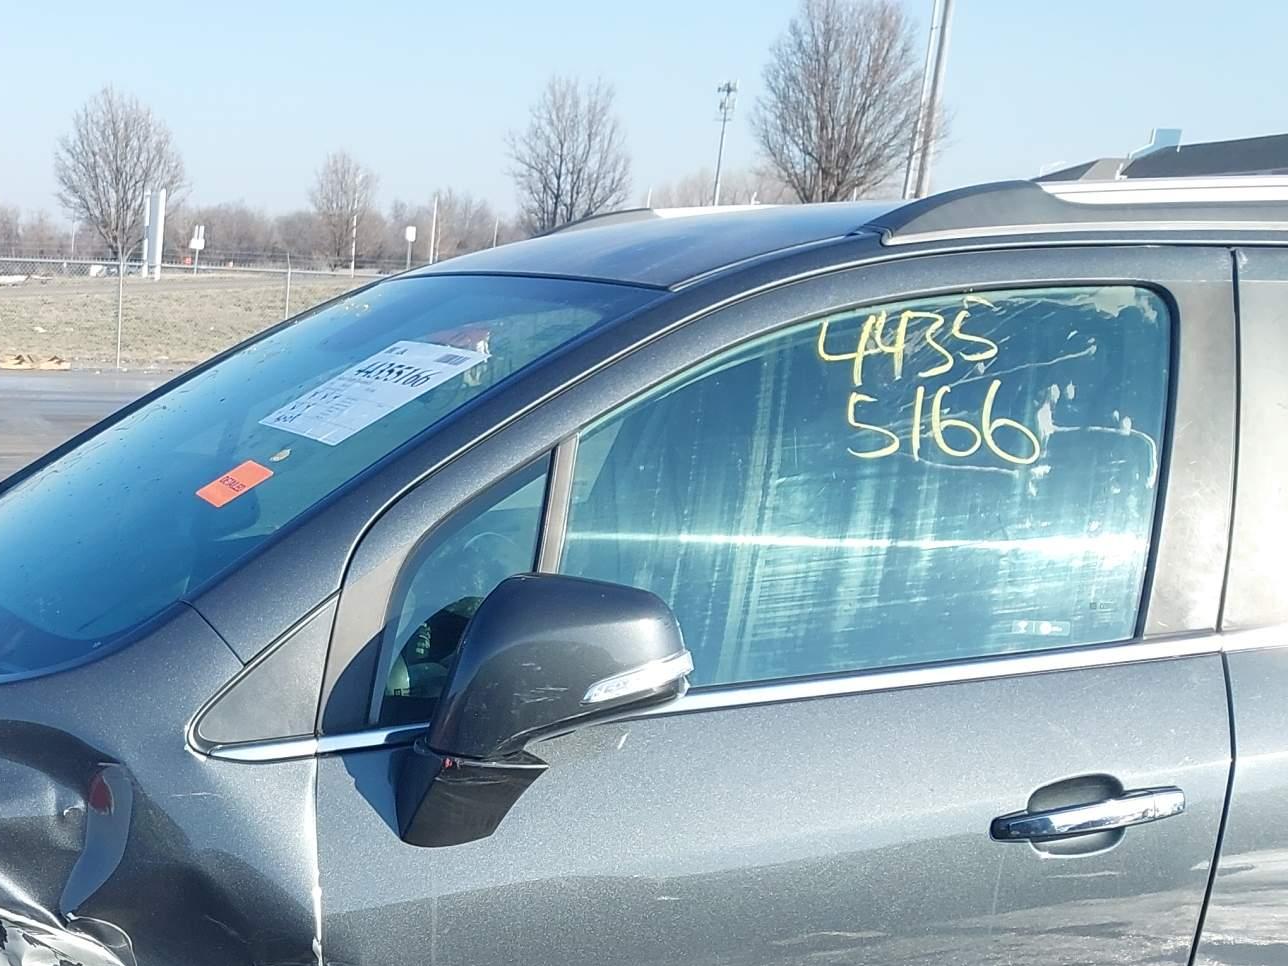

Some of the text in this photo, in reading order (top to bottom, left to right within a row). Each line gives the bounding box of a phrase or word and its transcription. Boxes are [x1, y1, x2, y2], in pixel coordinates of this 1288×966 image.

[354, 361, 442, 388] 44355166
[818, 295, 999, 386] 4435
[847, 380, 1040, 464] 5166
